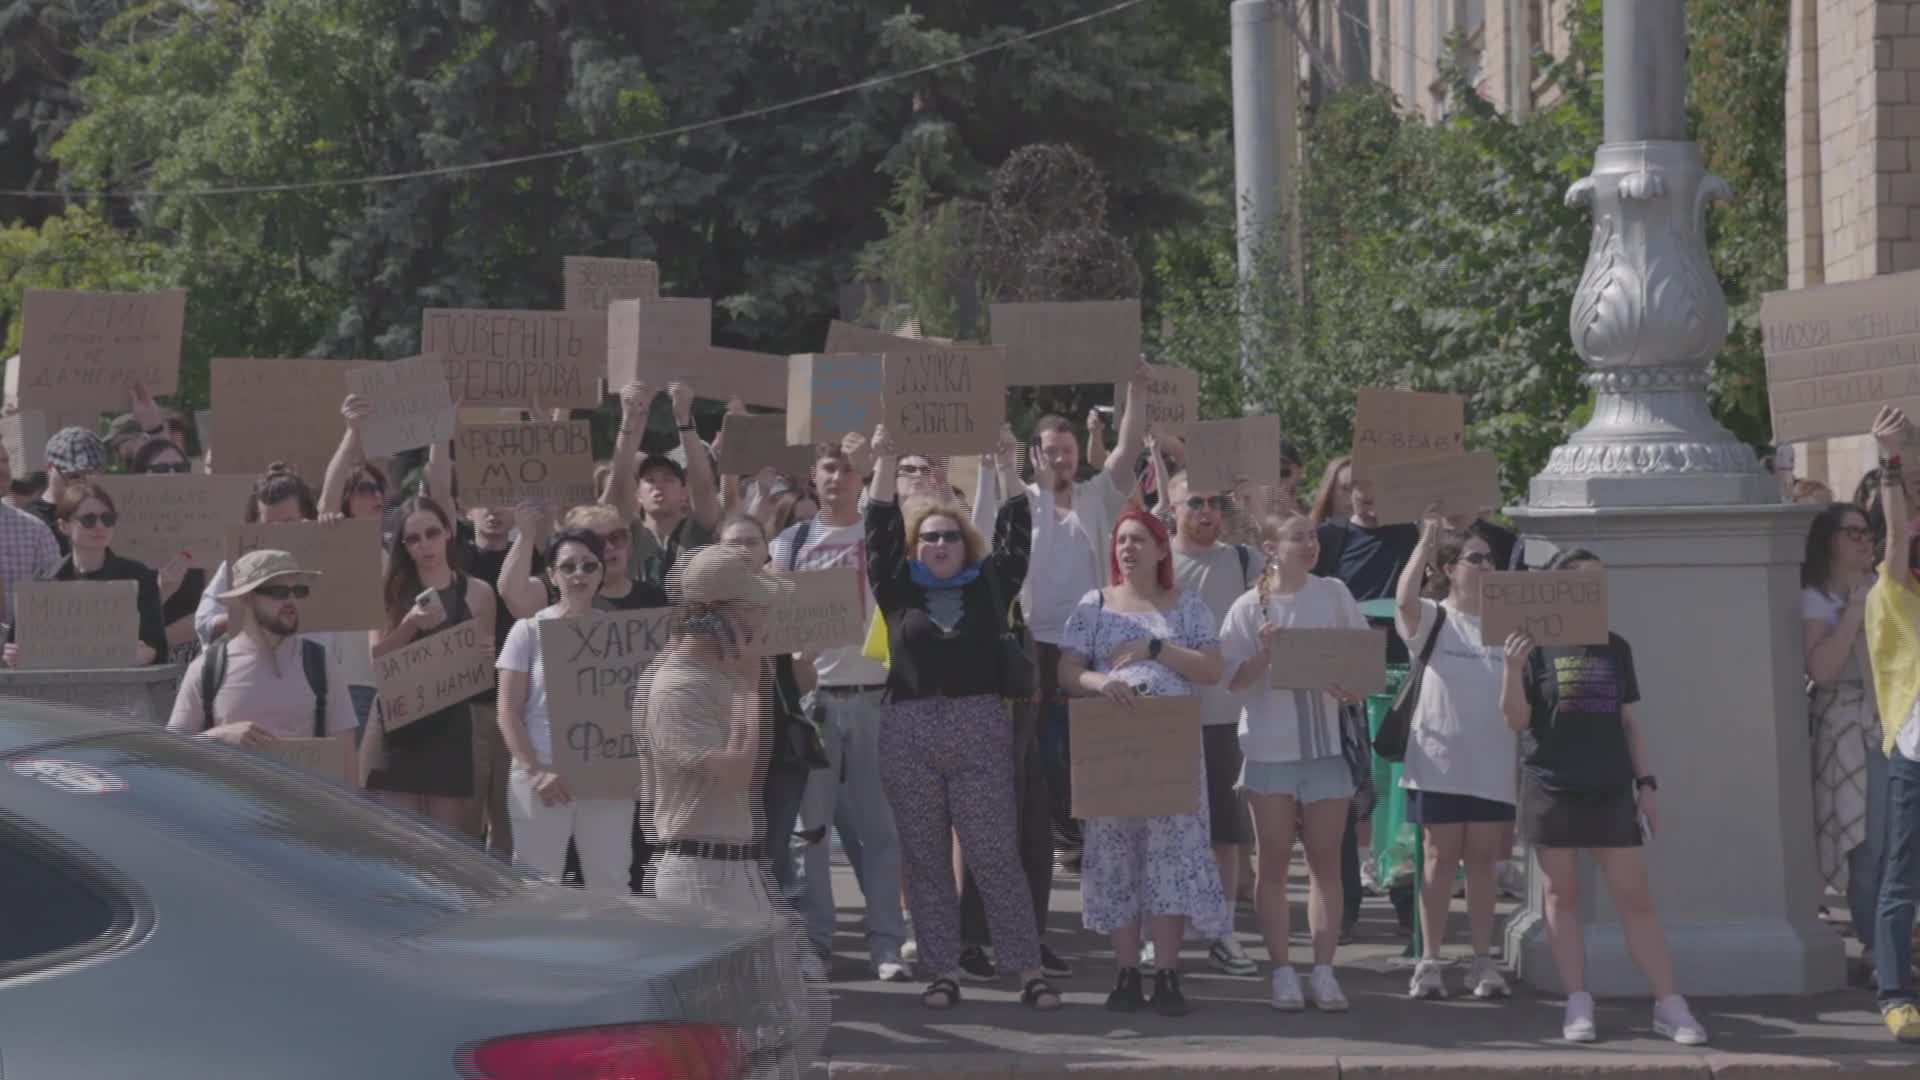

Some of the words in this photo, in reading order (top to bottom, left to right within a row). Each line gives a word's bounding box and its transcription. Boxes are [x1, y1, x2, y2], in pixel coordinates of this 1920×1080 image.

[430, 313, 582, 358] ПОВЕРНІТЬ
[1770, 319, 1831, 347] НАХУЯ
[460, 424, 589, 459] ФЕДОРОВ
[480, 459, 548, 485] МО
[1482, 582, 1601, 608] ФЕДОРОВ
[566, 616, 671, 663] ХАРКІ
[1525, 613, 1564, 637] МО
[382, 657, 401, 681] ЗА
[402, 645, 433, 670] ТИХ
[441, 627, 475, 657] ХТО
[386, 695, 408, 721] НЕ
[415, 683, 425, 711] З
[436, 663, 486, 698] НАМИ
[566, 721, 637, 762] Фед
